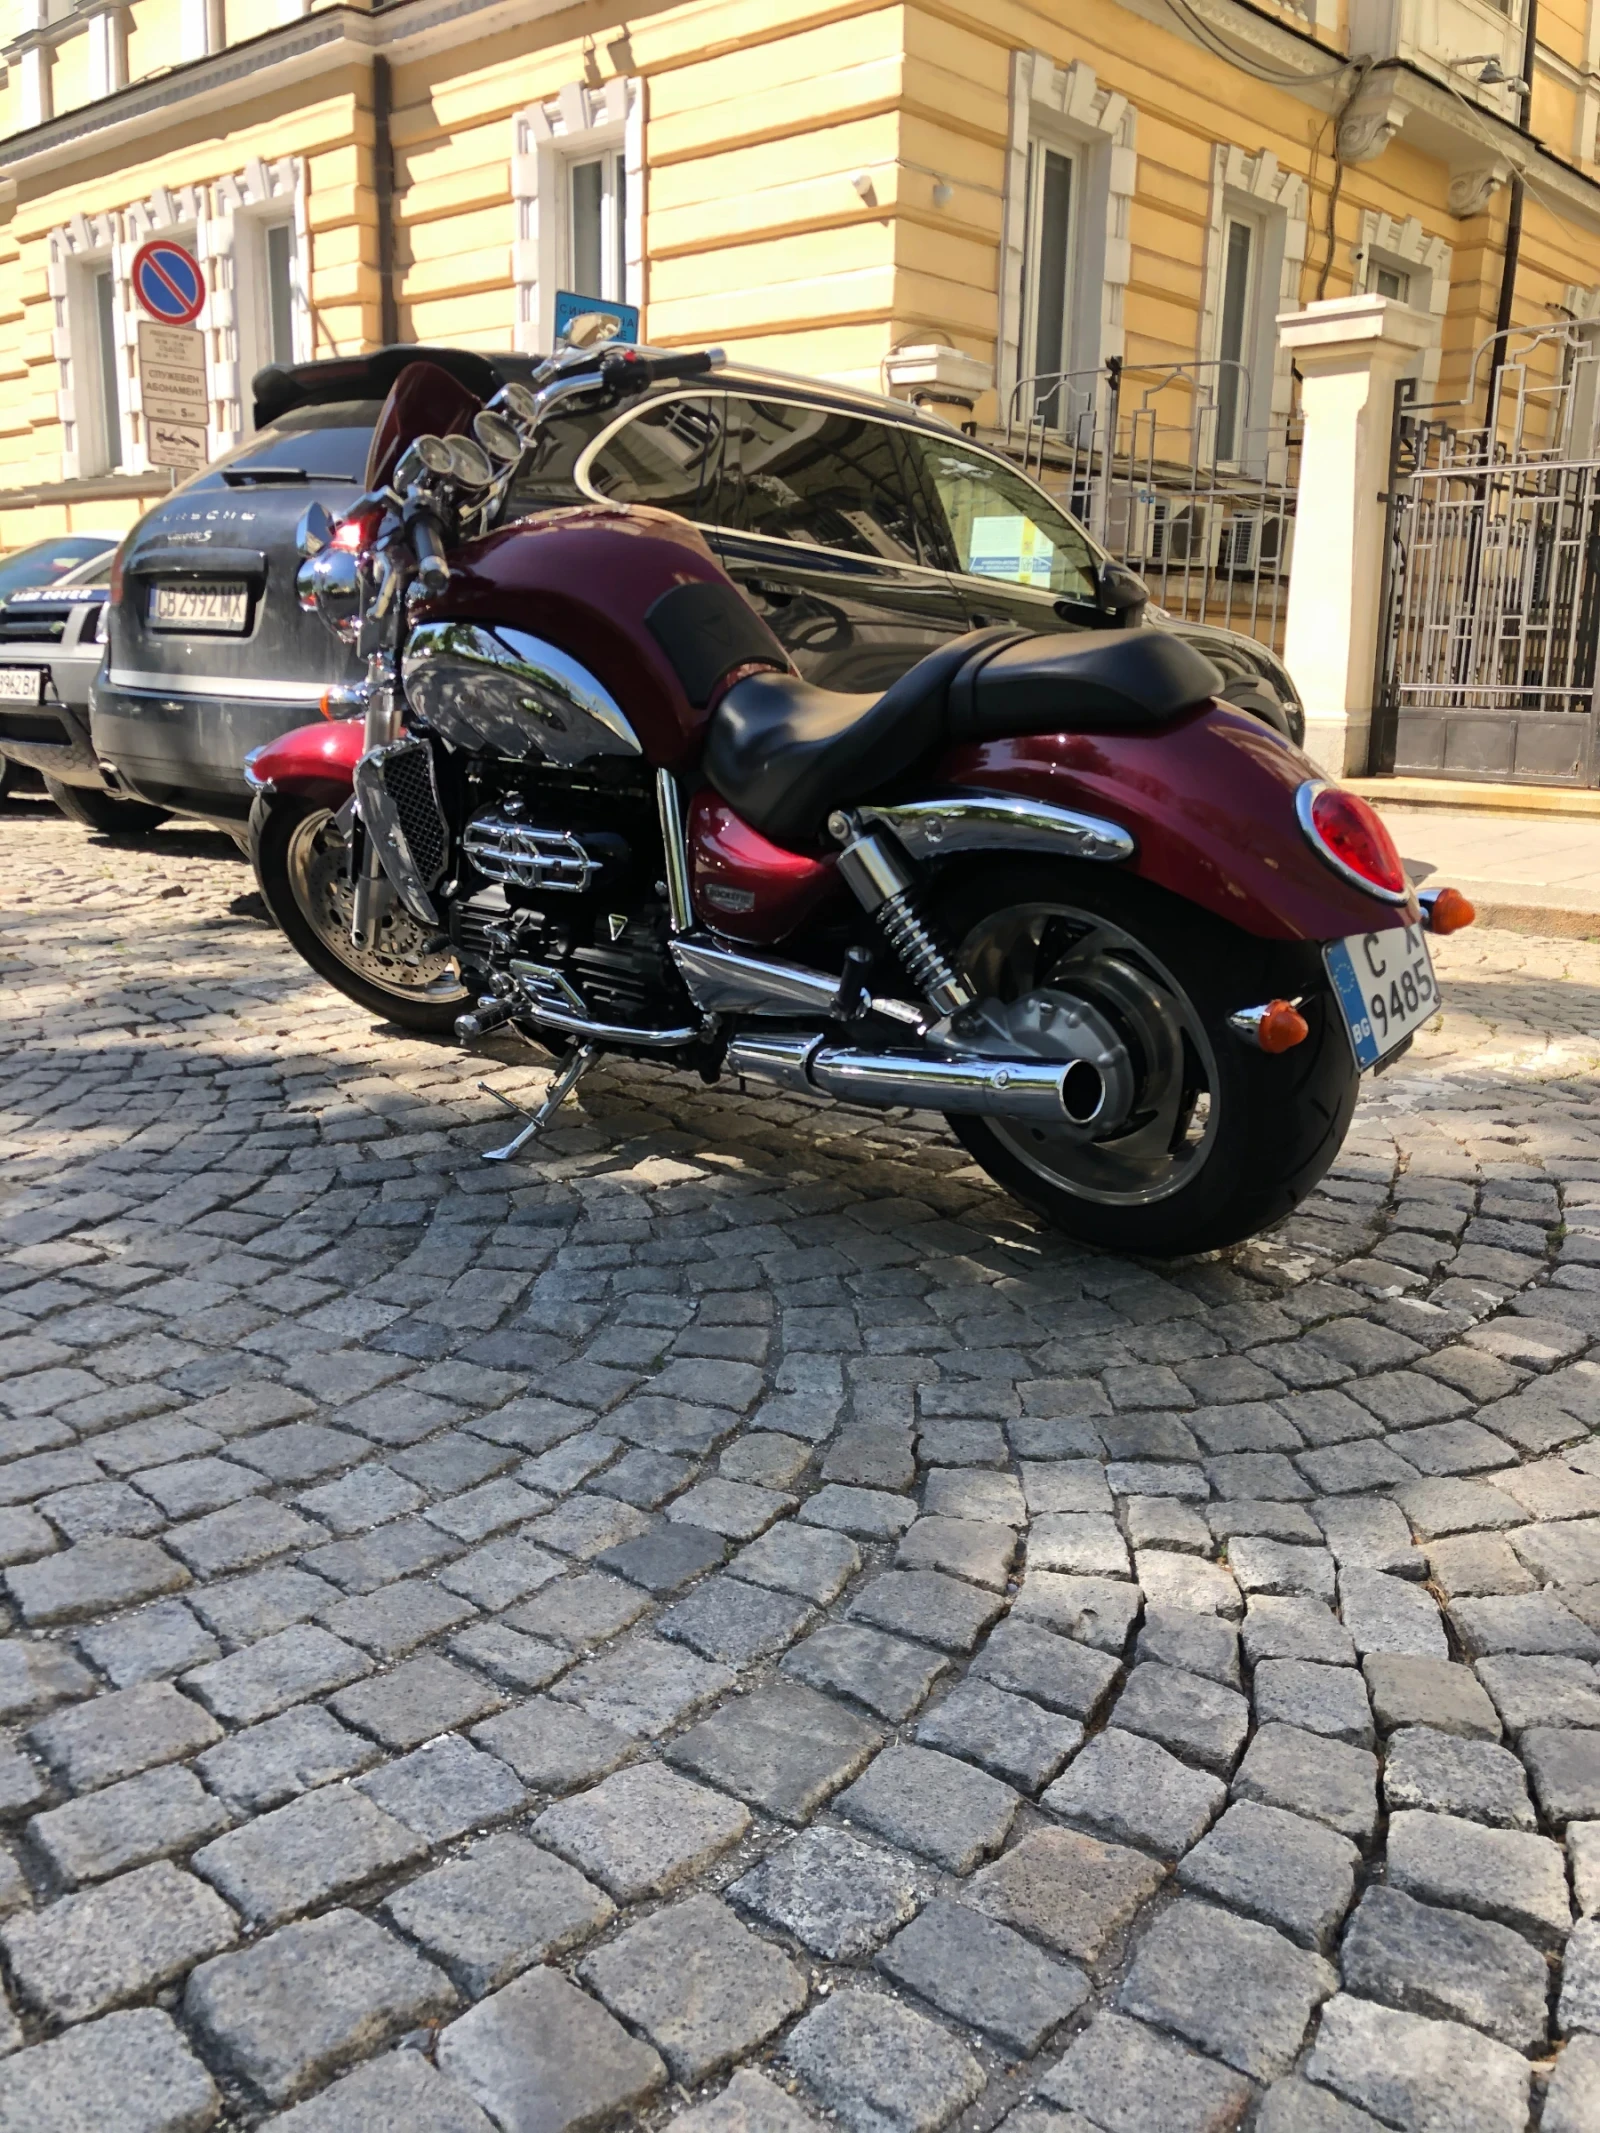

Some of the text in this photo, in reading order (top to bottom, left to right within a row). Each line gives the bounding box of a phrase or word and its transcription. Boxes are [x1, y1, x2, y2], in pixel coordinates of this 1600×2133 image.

[146, 381, 203, 397] АБОНАМЕНТ
[148, 369, 200, 384] СЛУЖЕБЕН
[10, 590, 92, 602] LAND ROVER
[178, 585, 217, 617] 2992
[219, 585, 243, 617] MX
[1363, 932, 1387, 978] C
[1371, 957, 1432, 1038] 9485
[1352, 1017, 1371, 1045] BG
